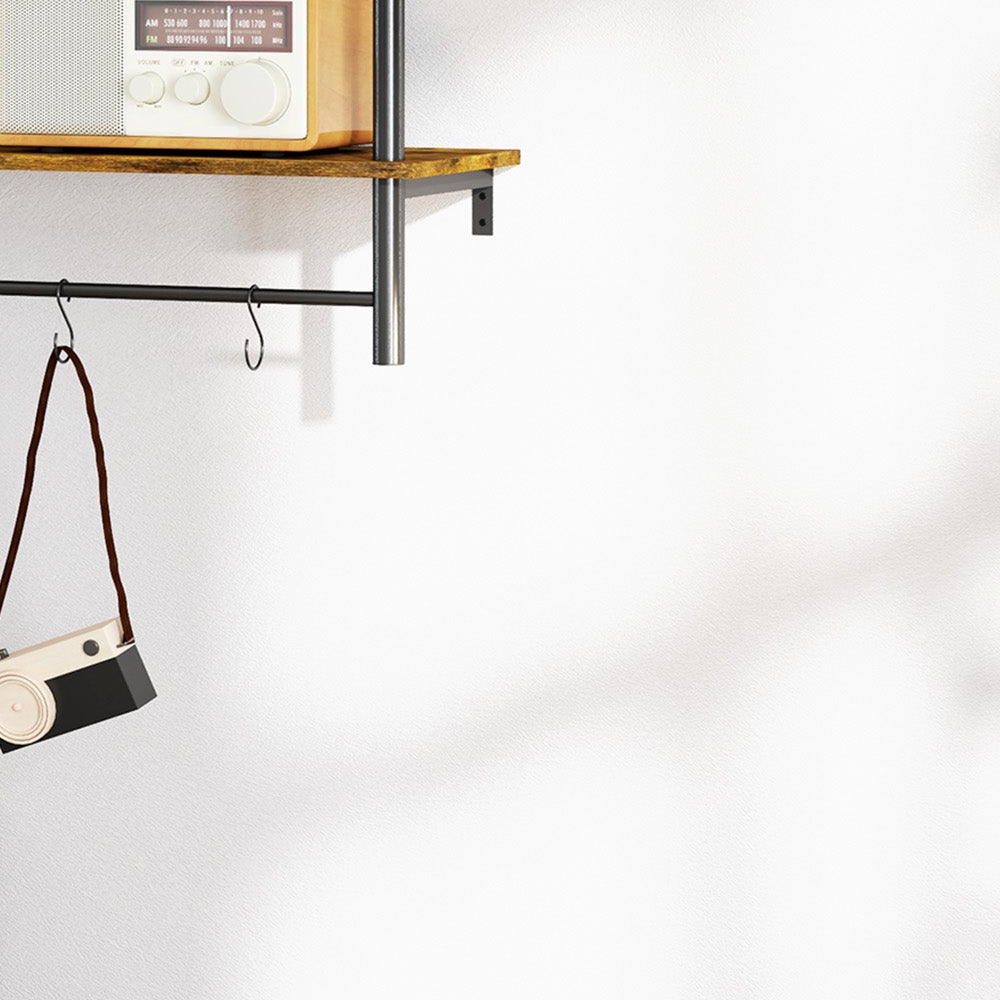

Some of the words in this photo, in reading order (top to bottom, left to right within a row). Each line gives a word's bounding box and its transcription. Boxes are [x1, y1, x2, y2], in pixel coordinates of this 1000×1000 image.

[145, 18, 159, 28] AM
[163, 18, 176, 28] 530
[176, 18, 188, 28] 600
[198, 18, 211, 28] 800
[235, 19, 250, 28] 1400
[250, 19, 266, 29] 1700
[146, 34, 158, 44] FM
[166, 34, 174, 44] 88
[175, 34, 183, 44] 90
[183, 34, 191, 44] 92
[199, 34, 208, 44] 96
[214, 34, 226, 45] 100
[233, 35, 245, 45] 104
[251, 35, 263, 45] 108
